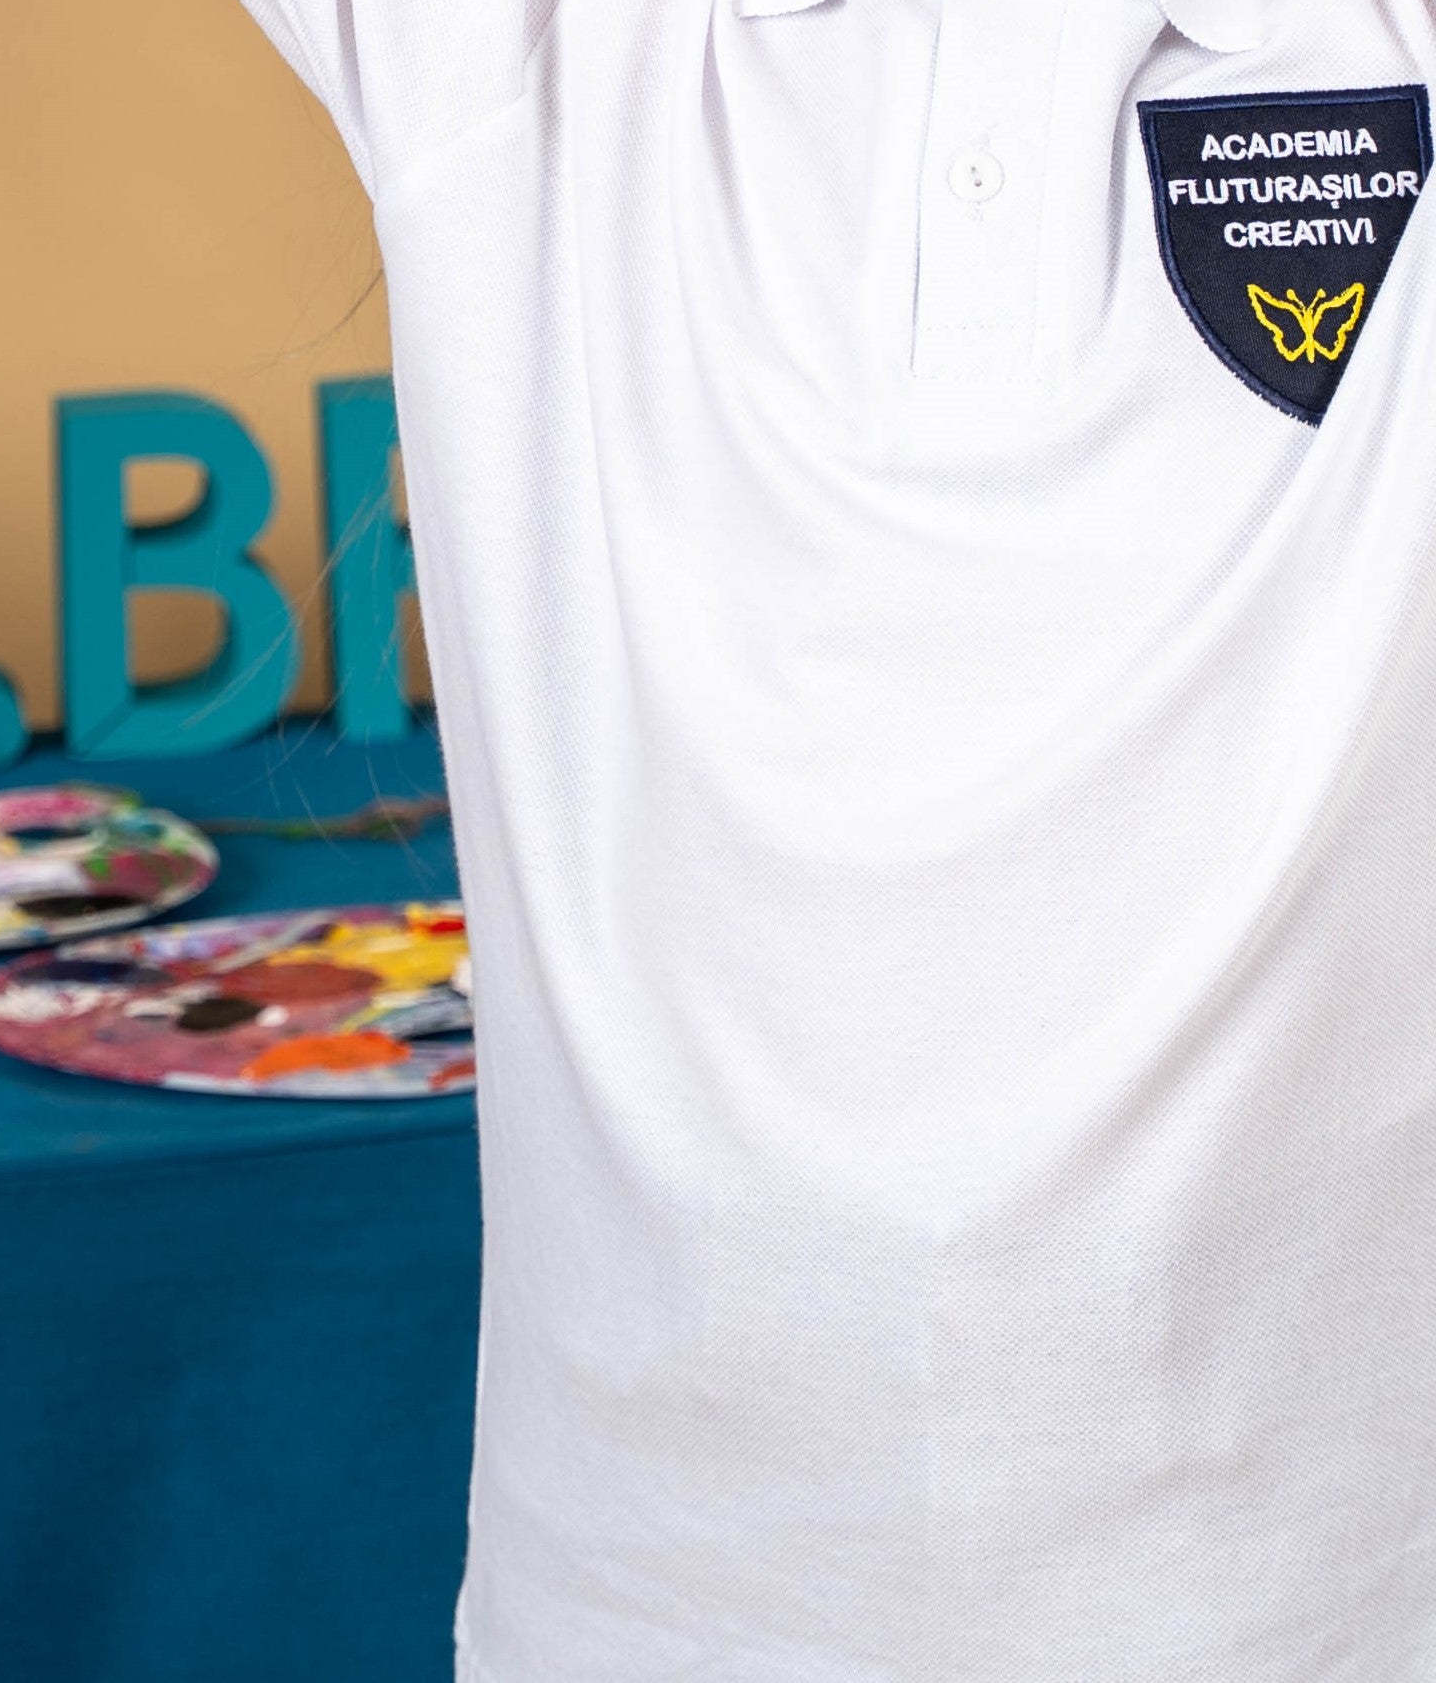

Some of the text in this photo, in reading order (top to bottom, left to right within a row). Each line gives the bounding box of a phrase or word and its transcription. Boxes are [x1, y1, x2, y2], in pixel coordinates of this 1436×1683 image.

[1200, 127, 1379, 163] ACADEMIA
[1167, 169, 1423, 209] FLUTURAȘILOR
[1223, 217, 1378, 249] CREATIVI
